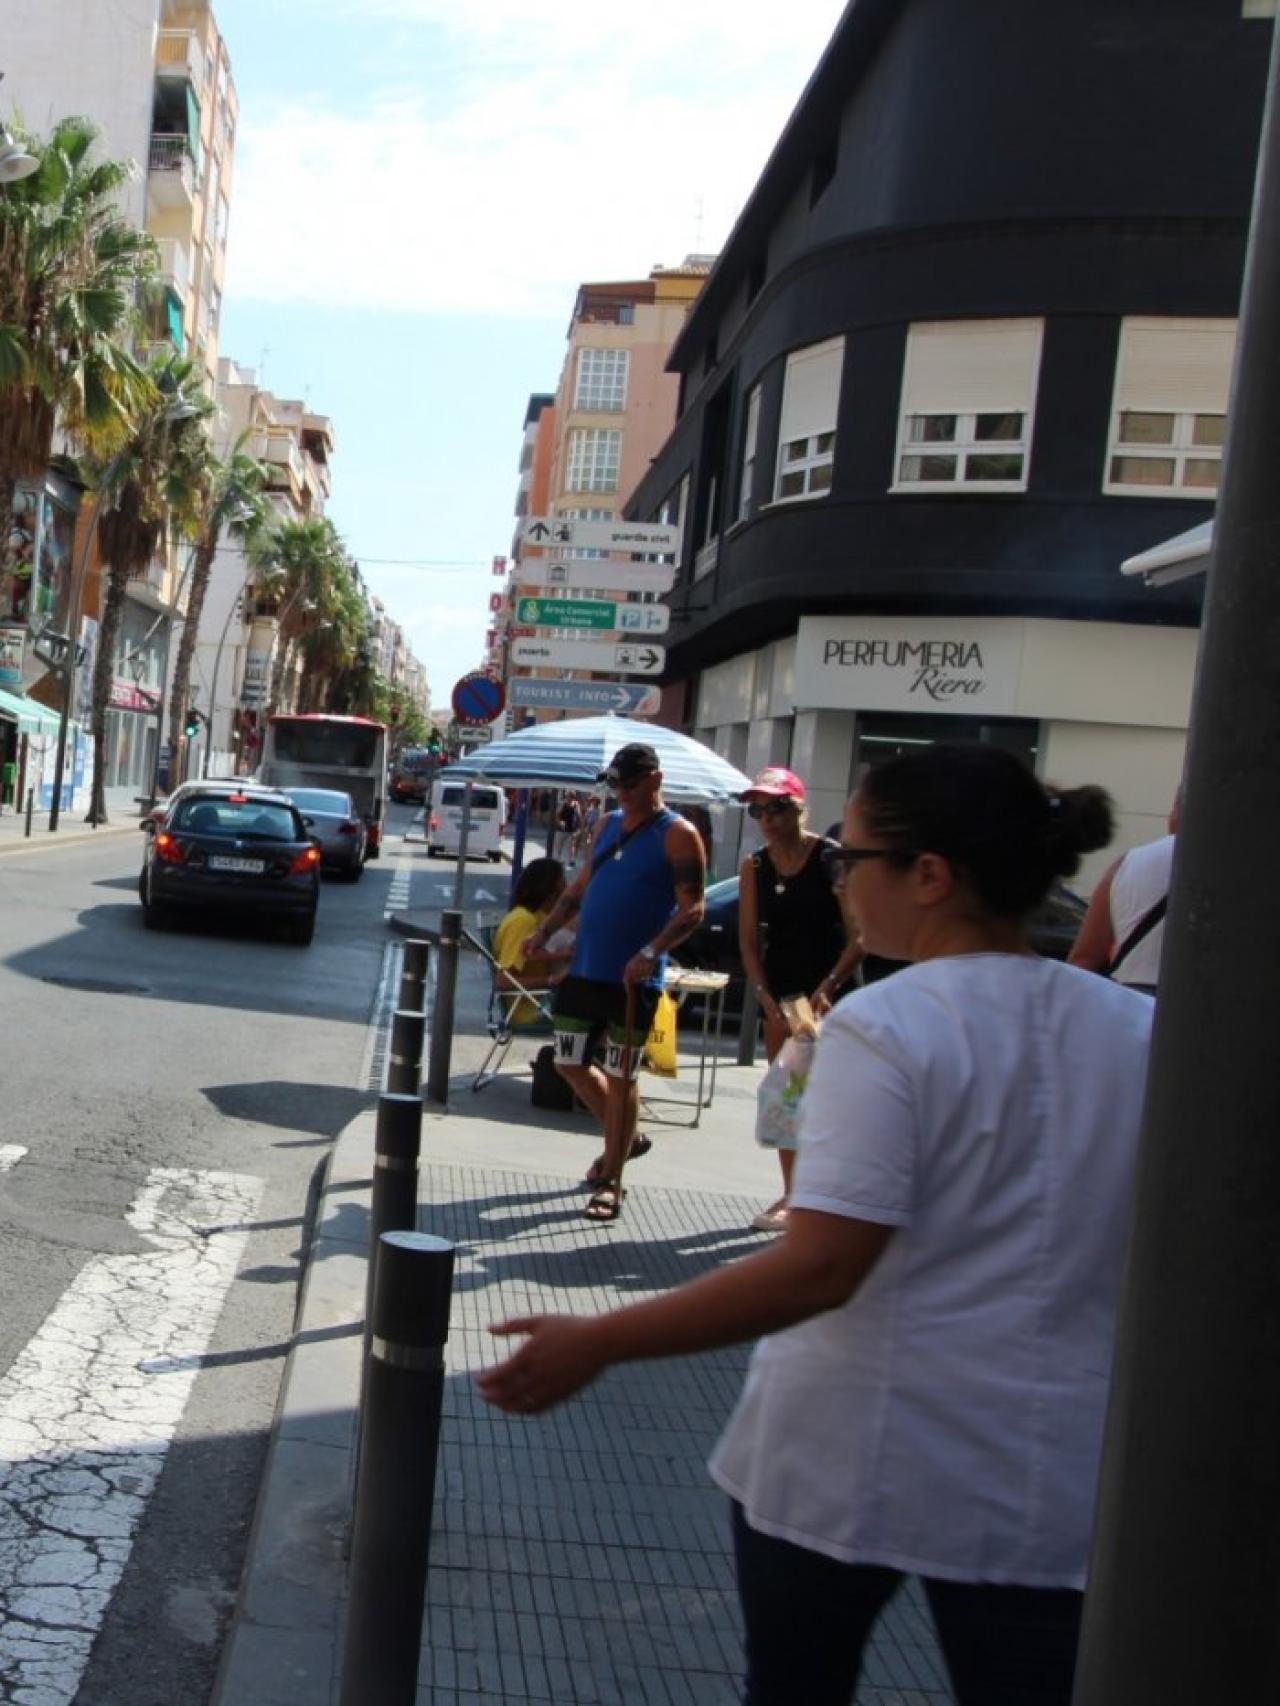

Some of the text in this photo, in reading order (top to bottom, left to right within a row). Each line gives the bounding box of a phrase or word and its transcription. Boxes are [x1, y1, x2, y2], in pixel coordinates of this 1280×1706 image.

[823, 639, 984, 669] PERFUMERIA
[514, 687, 610, 702] TOURIST INFO
[908, 667, 986, 702] Riera
